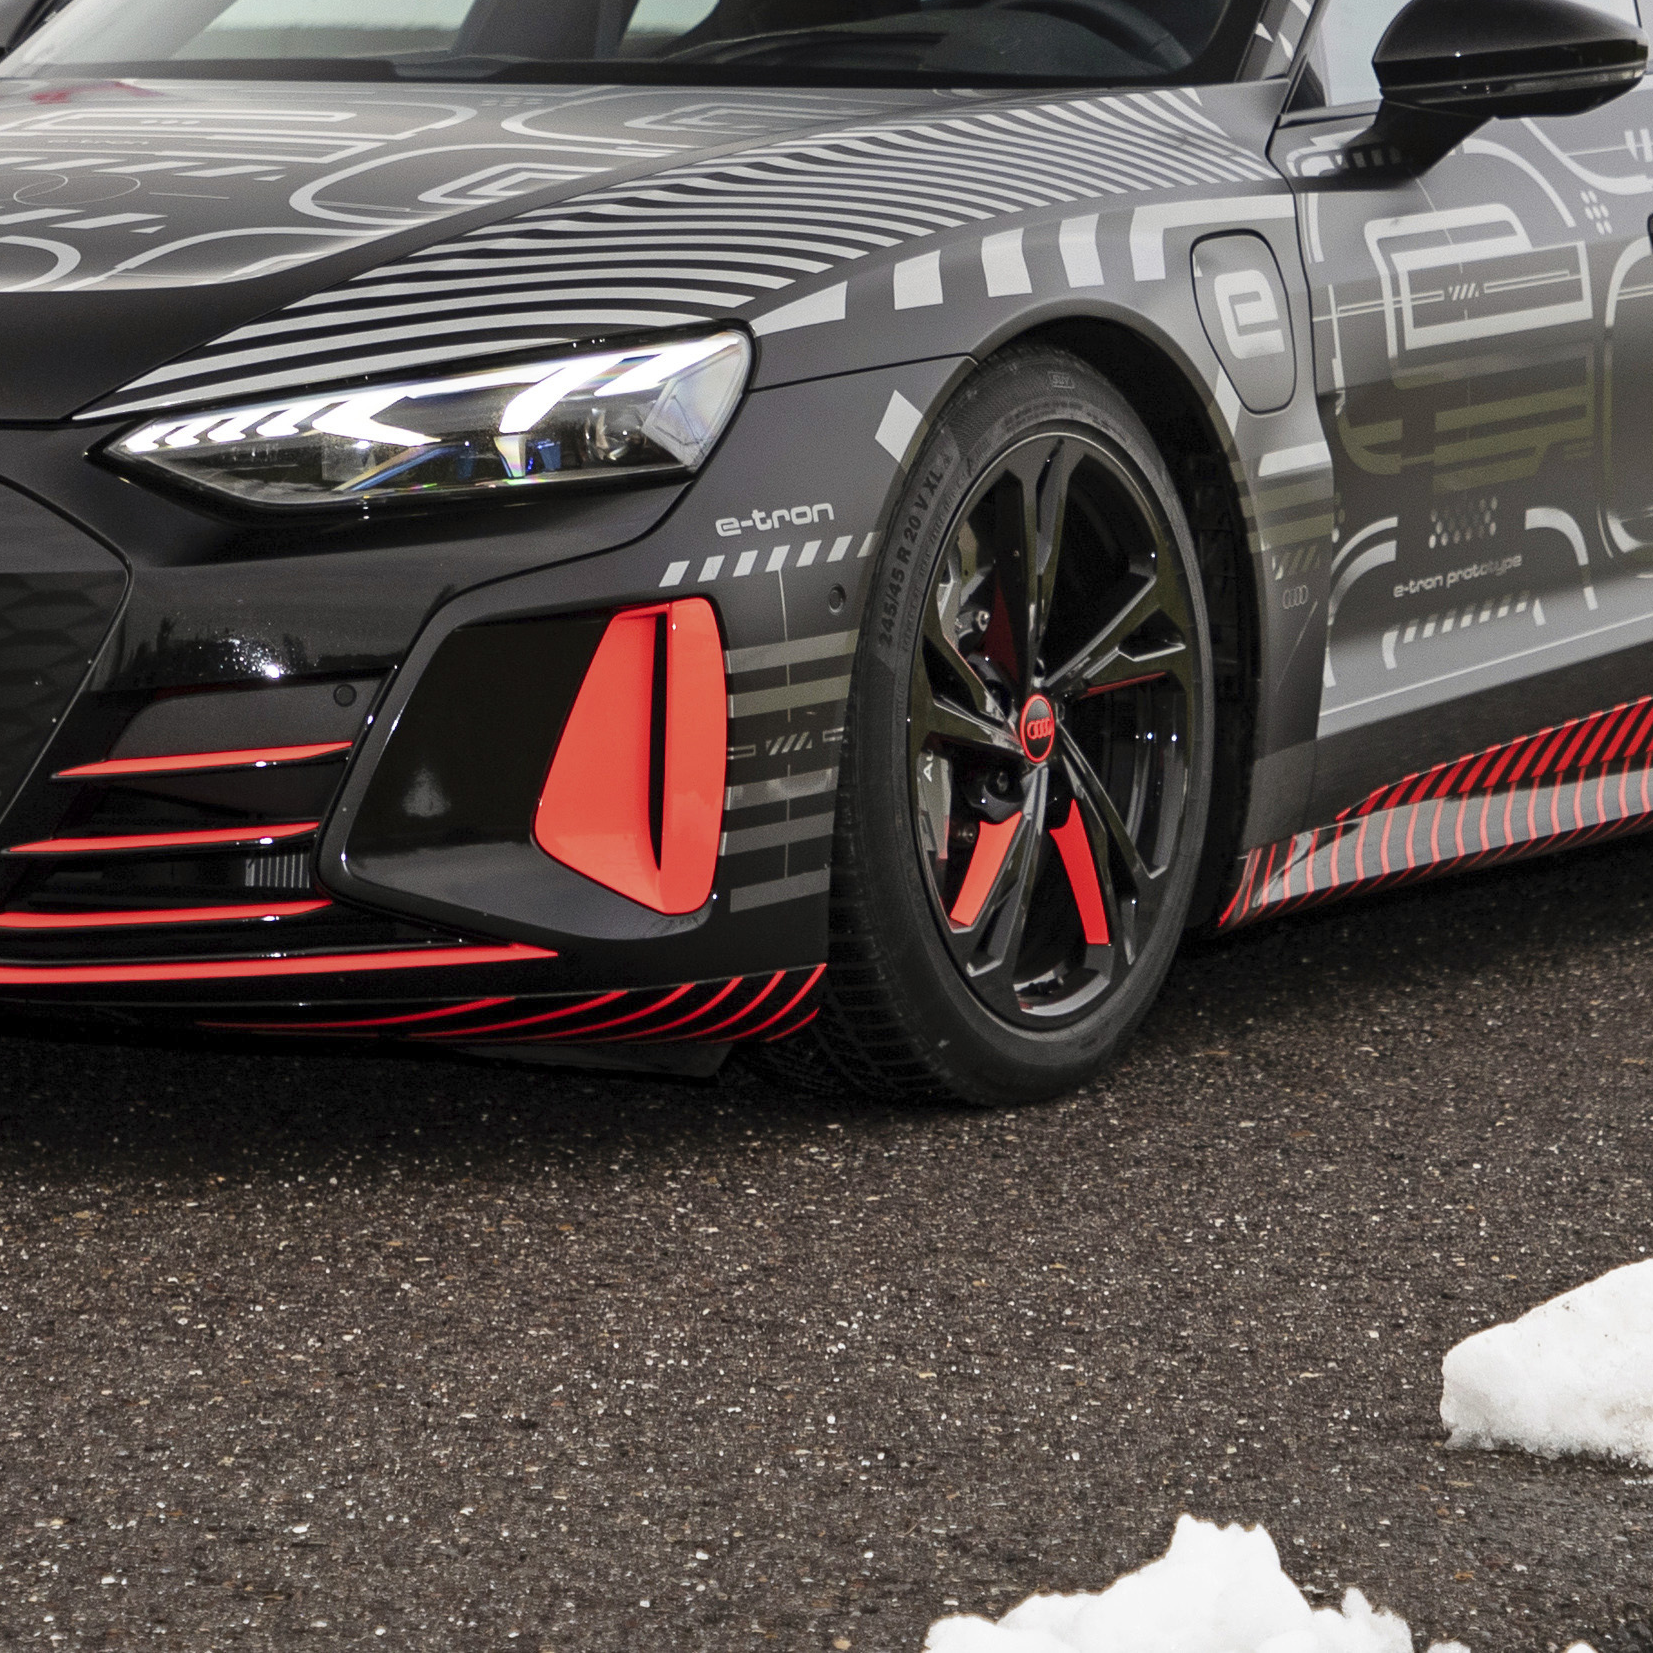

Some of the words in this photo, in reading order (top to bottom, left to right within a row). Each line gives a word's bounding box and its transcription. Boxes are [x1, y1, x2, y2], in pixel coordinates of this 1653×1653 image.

[716, 502, 835, 537] e-tron
[879, 567, 906, 648] 245/45
[896, 546, 912, 566] R
[904, 515, 922, 543] 20
[913, 493, 929, 512] V
[922, 469, 944, 497] XL
[1393, 575, 1444, 598] e-tron
[1446, 554, 1523, 589] prototype
